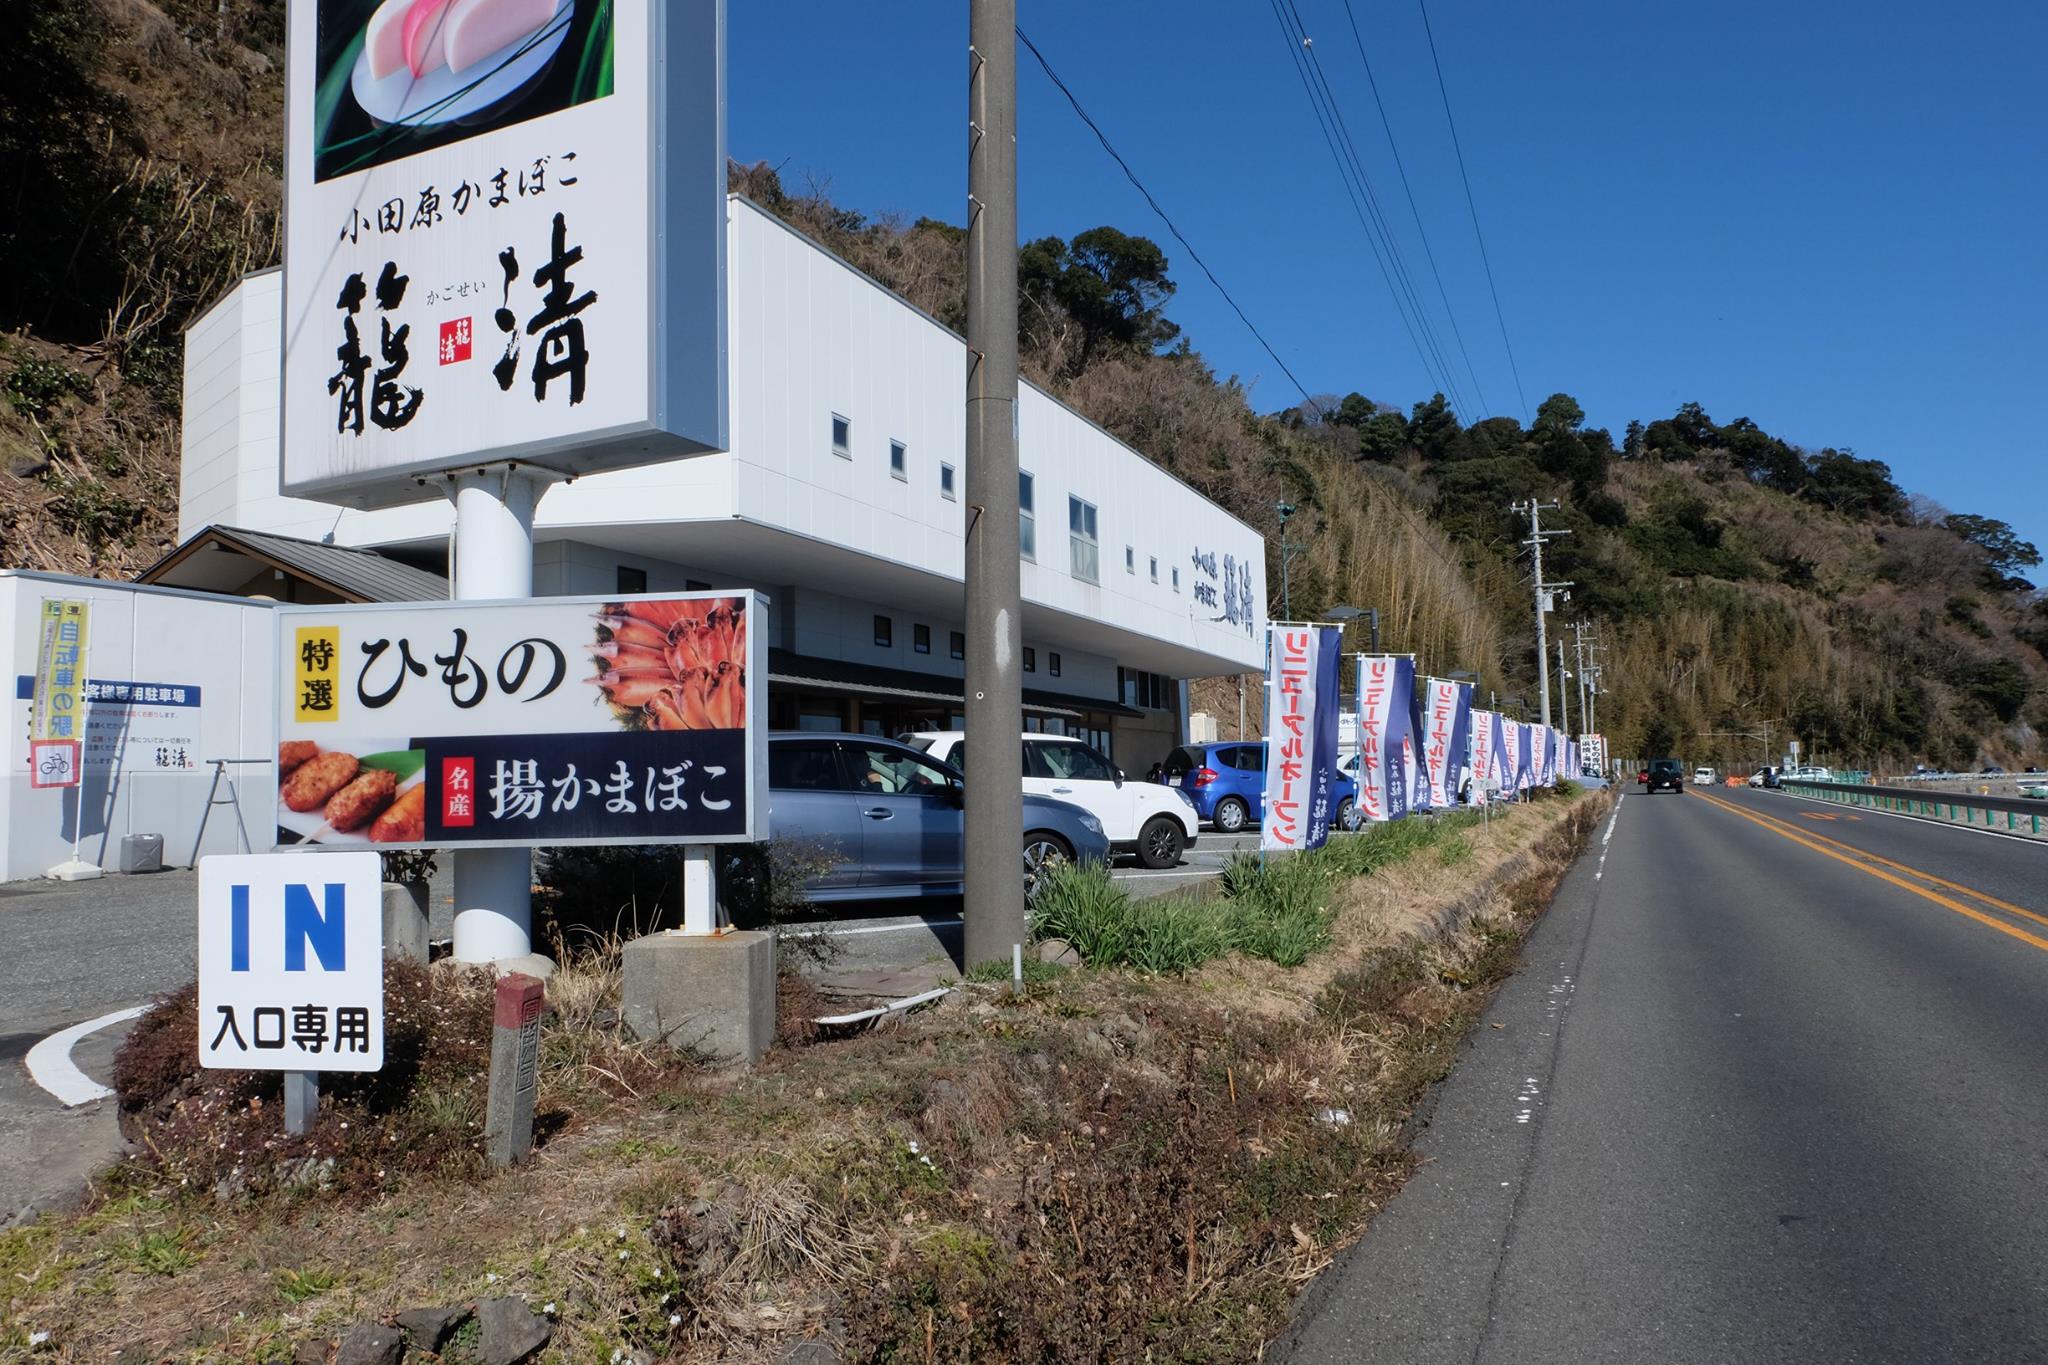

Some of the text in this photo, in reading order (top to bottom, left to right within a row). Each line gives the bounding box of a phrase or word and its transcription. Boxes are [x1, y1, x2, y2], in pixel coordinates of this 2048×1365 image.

[339, 151, 579, 244] 小田原かまぼこ
[426, 281, 486, 306] かごせい
[301, 638, 333, 712] 特選
[356, 627, 568, 710] ひもの
[447, 766, 471, 818] 名産
[488, 758, 732, 821] 揚かまぼこ
[231, 883, 346, 972] IN
[210, 1003, 370, 1054] 入口専用
